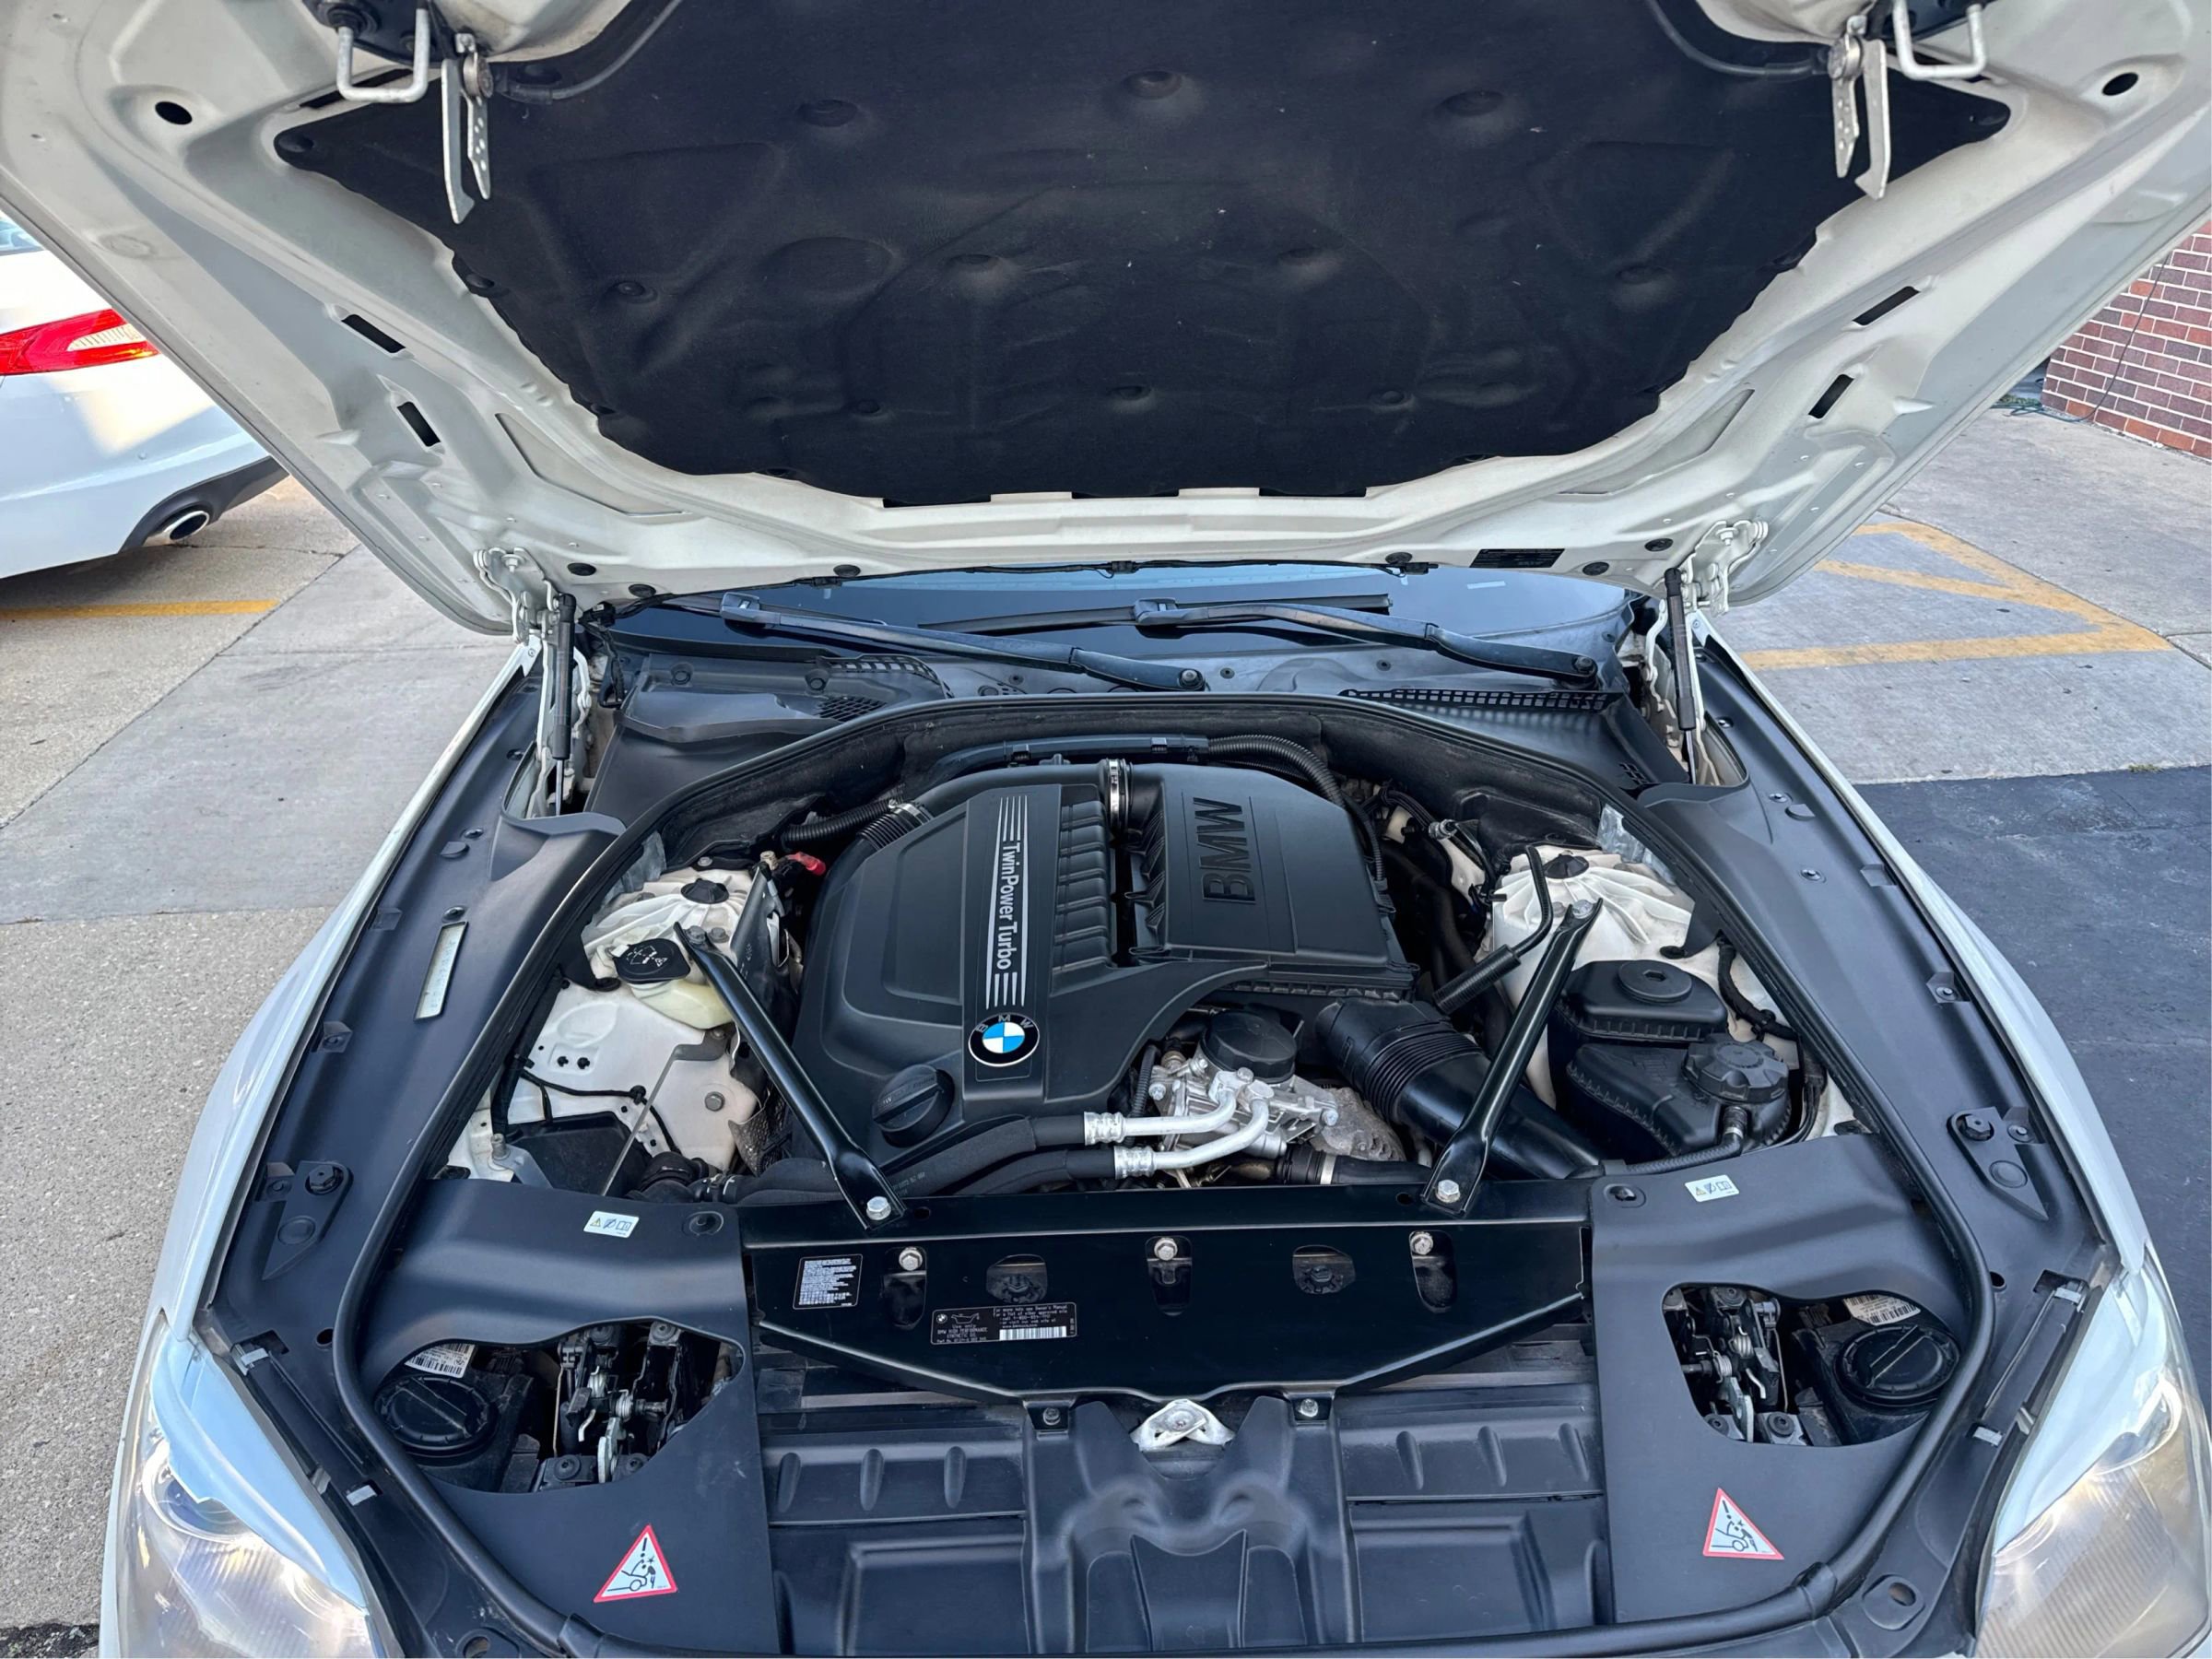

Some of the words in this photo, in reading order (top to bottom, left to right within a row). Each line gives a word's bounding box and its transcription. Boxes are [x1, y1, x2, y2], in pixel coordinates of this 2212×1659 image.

[999, 842, 1021, 921] TwinPower
[1193, 797, 1255, 904] BMW
[996, 922, 1018, 970] Turbo
[976, 1014, 1034, 1033] BMW
